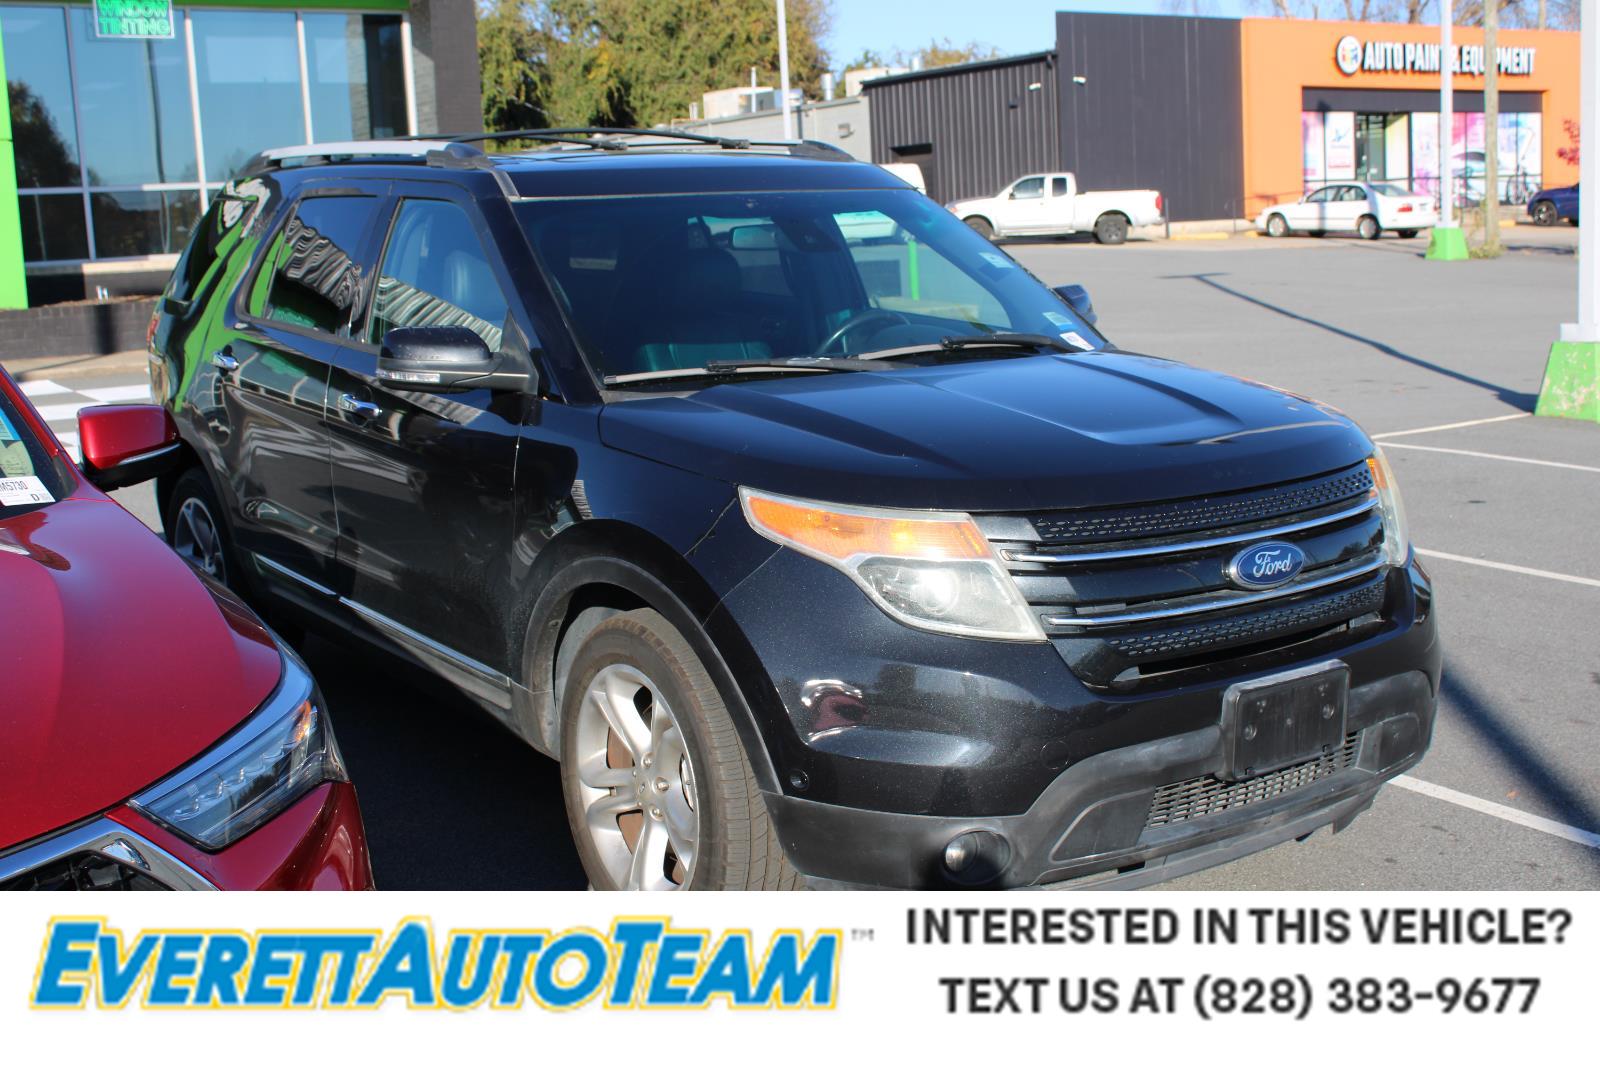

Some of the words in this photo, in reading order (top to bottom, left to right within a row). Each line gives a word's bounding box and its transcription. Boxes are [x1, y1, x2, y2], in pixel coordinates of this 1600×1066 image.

[98, 18, 170, 35] TINTING
[1365, 42, 1403, 71] AUTO
[1404, 44, 1443, 72] PAIN
[1253, 549, 1293, 577] Ford
